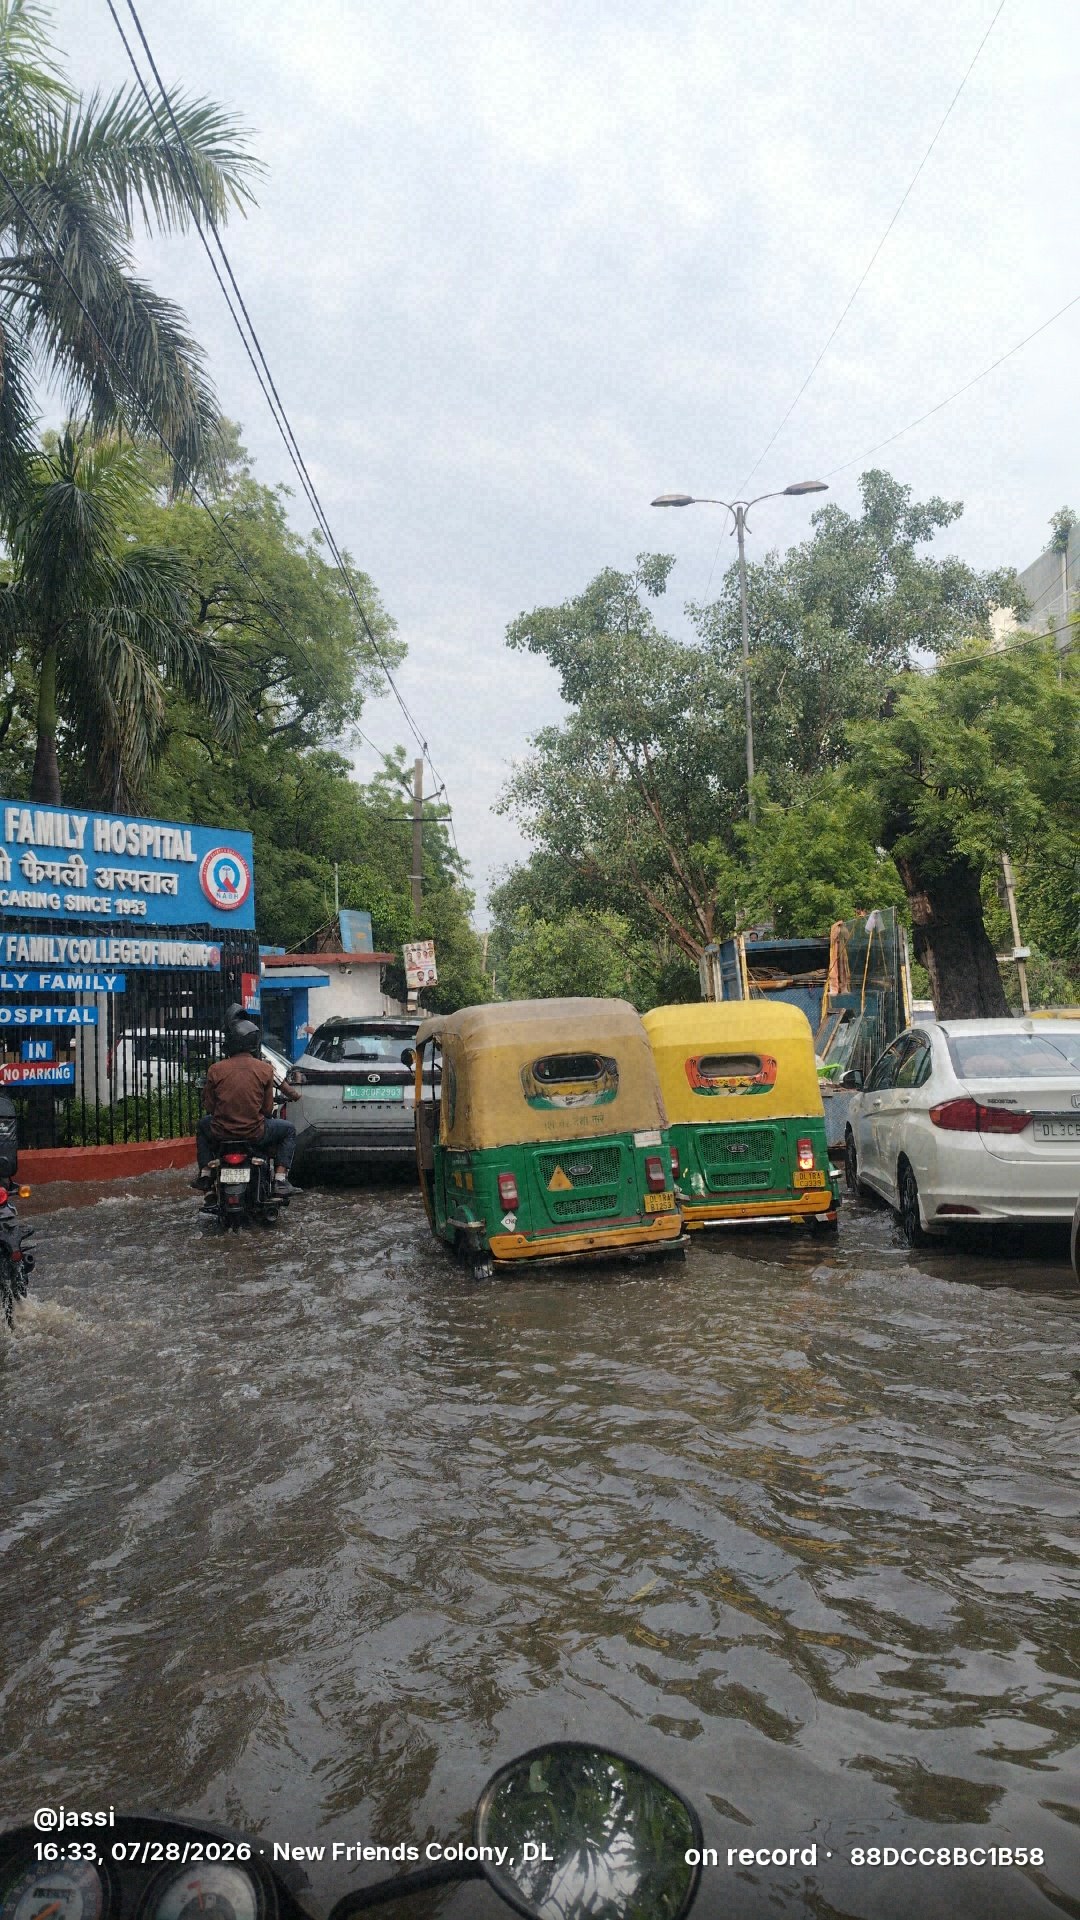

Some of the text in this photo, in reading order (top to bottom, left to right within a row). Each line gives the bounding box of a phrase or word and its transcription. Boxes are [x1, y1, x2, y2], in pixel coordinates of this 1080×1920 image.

[5, 807, 88, 849] FAMILY
[93, 818, 197, 862] HOSPITAL
[94, 867, 179, 896] अस्पताल
[0, 890, 147, 916] CARING SINCE 1953
[39, 975, 117, 990] FAMILY
[28, 1042, 47, 1059] IN
[3, 1067, 71, 1081] NO PARKING
